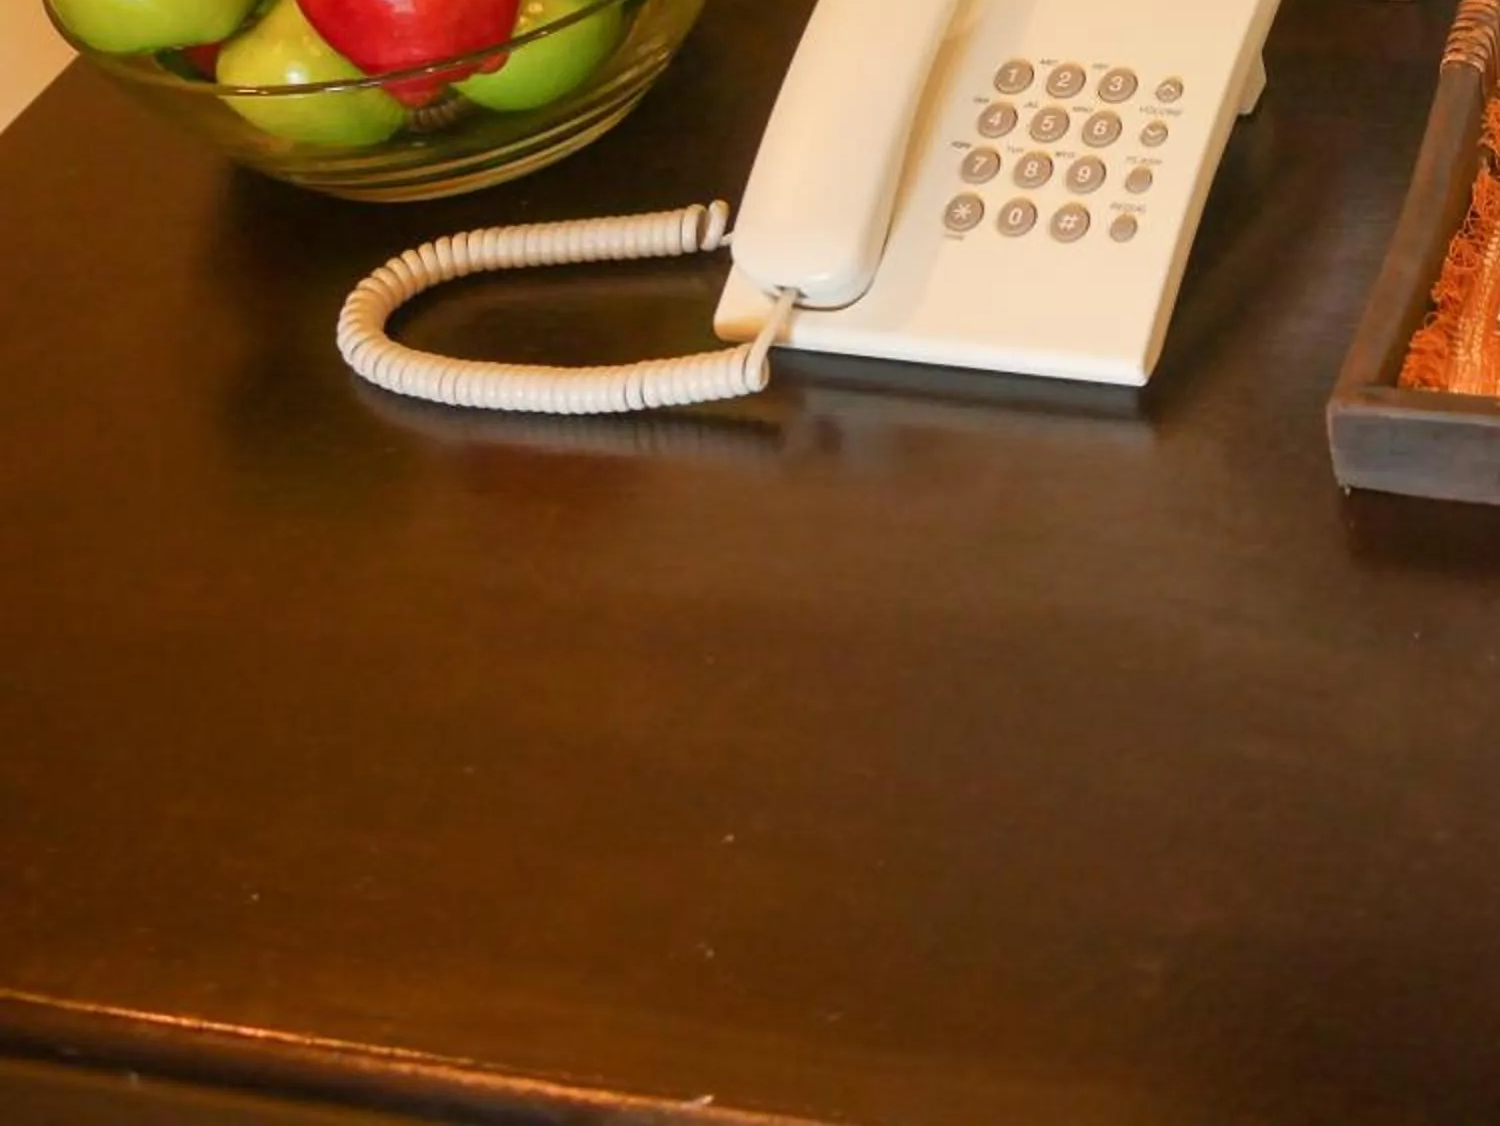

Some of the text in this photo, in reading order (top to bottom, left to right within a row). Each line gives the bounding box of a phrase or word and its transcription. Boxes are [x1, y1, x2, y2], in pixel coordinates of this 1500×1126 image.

[1007, 68, 1018, 84] 1
[1057, 71, 1072, 87] 2
[1108, 76, 1123, 91] 3
[988, 111, 1002, 126] 4
[1041, 115, 1056, 131] 5
[1093, 120, 1108, 135] 6
[972, 156, 988, 173] 7
[1024, 161, 1039, 177] 8
[1077, 165, 1091, 182] 9
[1008, 207, 1023, 225] 0
